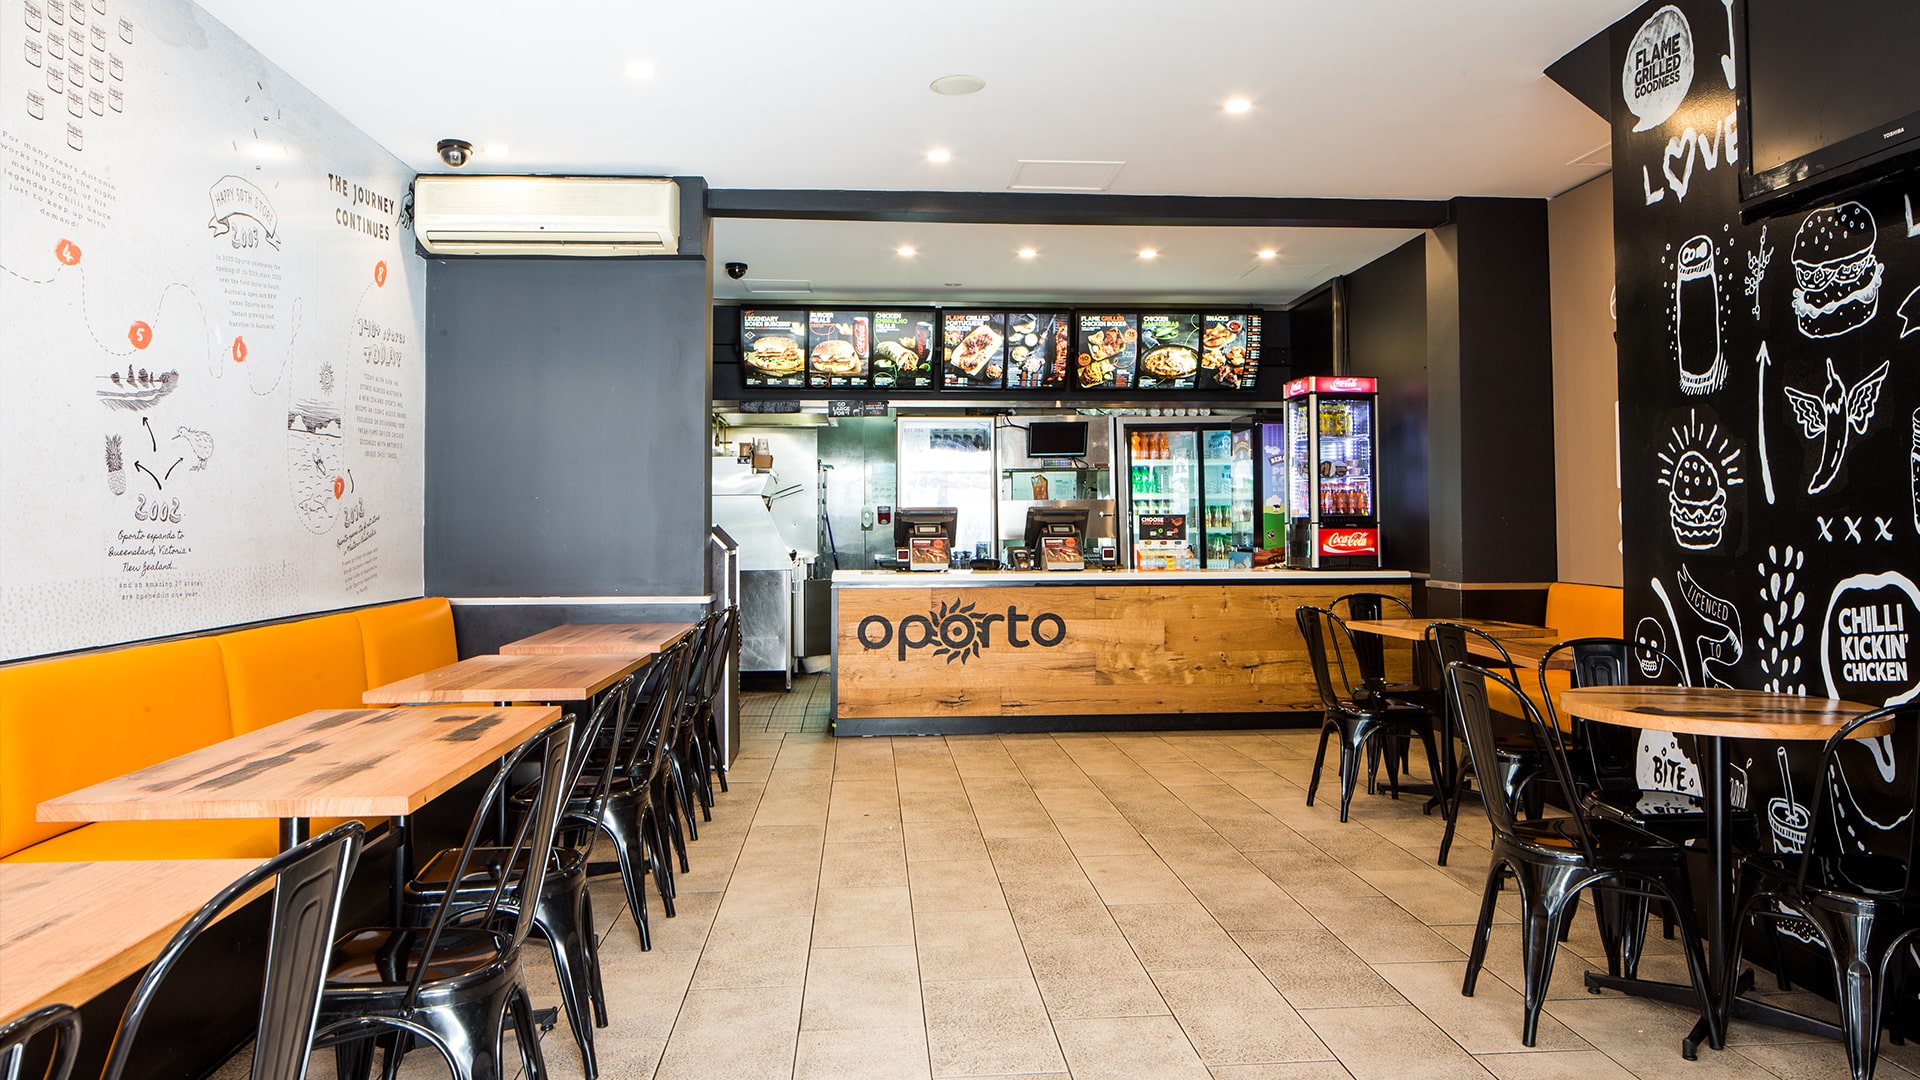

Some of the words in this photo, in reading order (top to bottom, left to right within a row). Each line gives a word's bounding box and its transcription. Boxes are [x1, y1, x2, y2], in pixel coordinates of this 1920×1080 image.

[1636, 33, 1681, 70] FLAME
[1635, 54, 1681, 86] GRILLED
[1635, 70, 1680, 98] GOODNESS
[1883, 127, 1905, 139] TOSHIBA
[2, 131, 19, 143] For
[24, 142, 49, 159] many
[53, 156, 78, 173] years
[82, 170, 116, 191] Antonio
[12, 160, 47, 182] making
[4, 168, 54, 196] legendary
[34, 160, 73, 181] through
[94, 188, 117, 201] night
[328, 173, 348, 197] THE
[353, 184, 394, 215] JOURNEY
[8, 184, 29, 196] just
[34, 193, 43, 202] to
[48, 200, 68, 213] keep
[72, 211, 83, 220] up
[87, 216, 106, 229] with
[215, 188, 234, 207] HAPPY
[236, 188, 252, 204] 50TH
[255, 197, 273, 226] STORE
[336, 208, 390, 241] CONTINUES
[62, 243, 73, 262] 4
[136, 328, 145, 342] 5
[364, 342, 402, 368] TODAY
[135, 493, 181, 524] 2002
[118, 530, 146, 544] Oporto
[177, 529, 185, 540] to
[159, 545, 187, 555] Victoria
[1328, 531, 1370, 547] Coca-Cola
[123, 562, 140, 572] New
[1688, 585, 1729, 621] LICENCED
[857, 602, 1067, 662] oporto
[1839, 604, 1904, 635] CHILLI
[1709, 642, 1721, 658] TO
[1841, 634, 1909, 660] KICKIN'
[1843, 662, 1908, 682] CHICKEN
[1653, 756, 1688, 791] BITE
